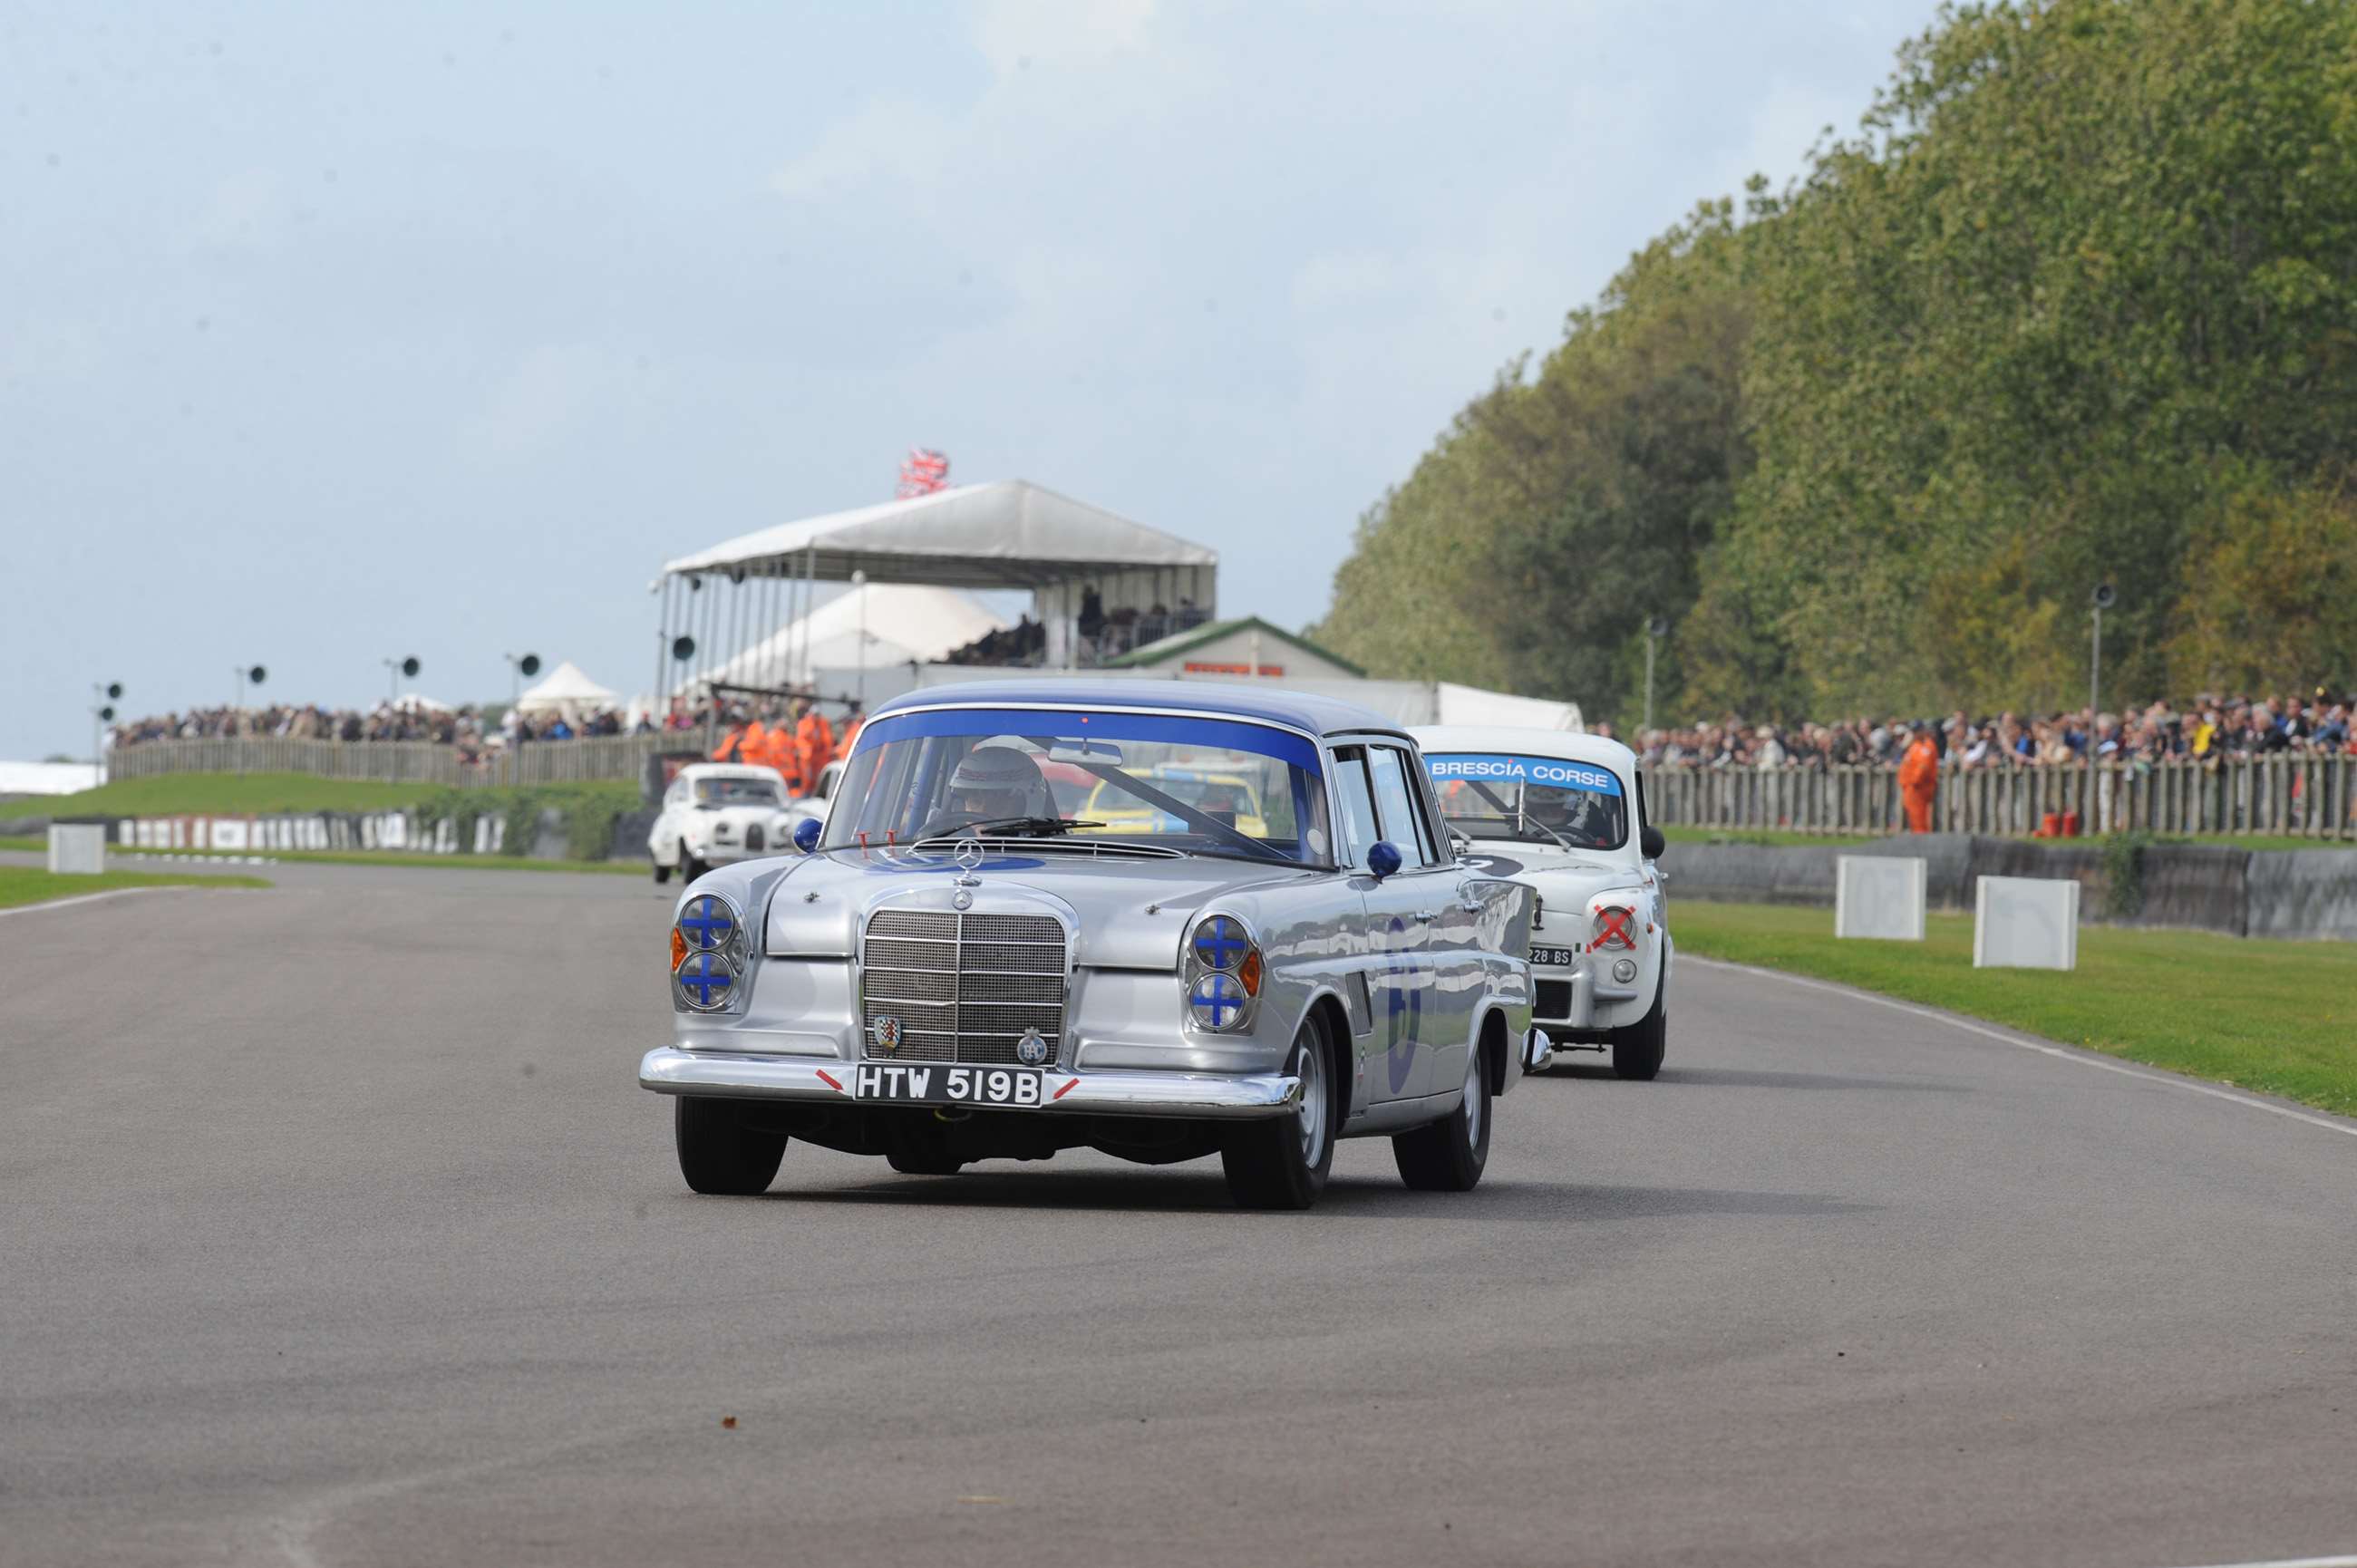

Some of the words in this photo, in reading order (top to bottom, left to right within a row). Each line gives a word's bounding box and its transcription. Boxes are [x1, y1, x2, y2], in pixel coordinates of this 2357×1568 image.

[1431, 761, 1526, 777] BRESCIA
[1532, 766, 1608, 788] CORSE
[857, 1067, 931, 1099] HTW
[946, 1069, 1039, 1104] 519B
